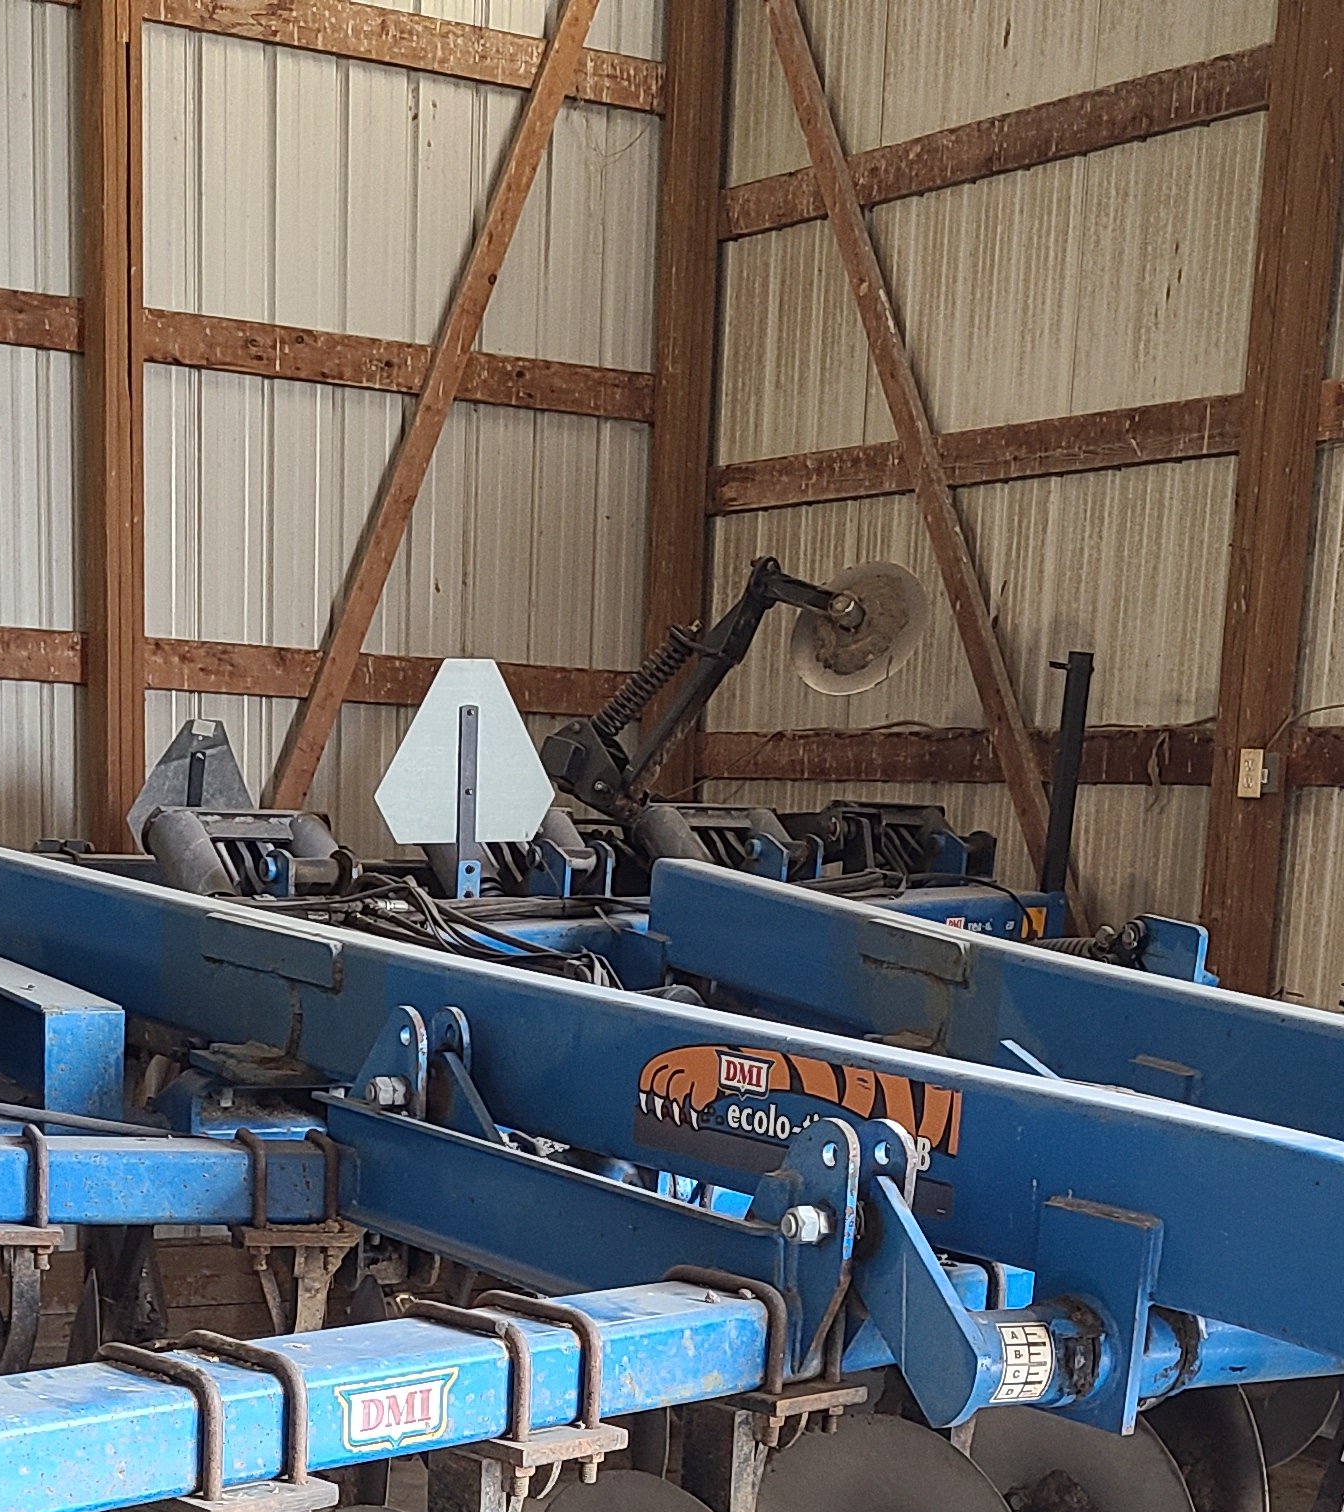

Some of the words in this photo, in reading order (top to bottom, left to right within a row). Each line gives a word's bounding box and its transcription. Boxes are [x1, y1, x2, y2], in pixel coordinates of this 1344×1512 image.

[725, 1060, 764, 1089] DMI
[1010, 1331, 1019, 1340] A
[1013, 1350, 1021, 1359] B
[1012, 1370, 1021, 1379] C
[1005, 1388, 1013, 1396] D
[360, 1388, 432, 1433] DMI
